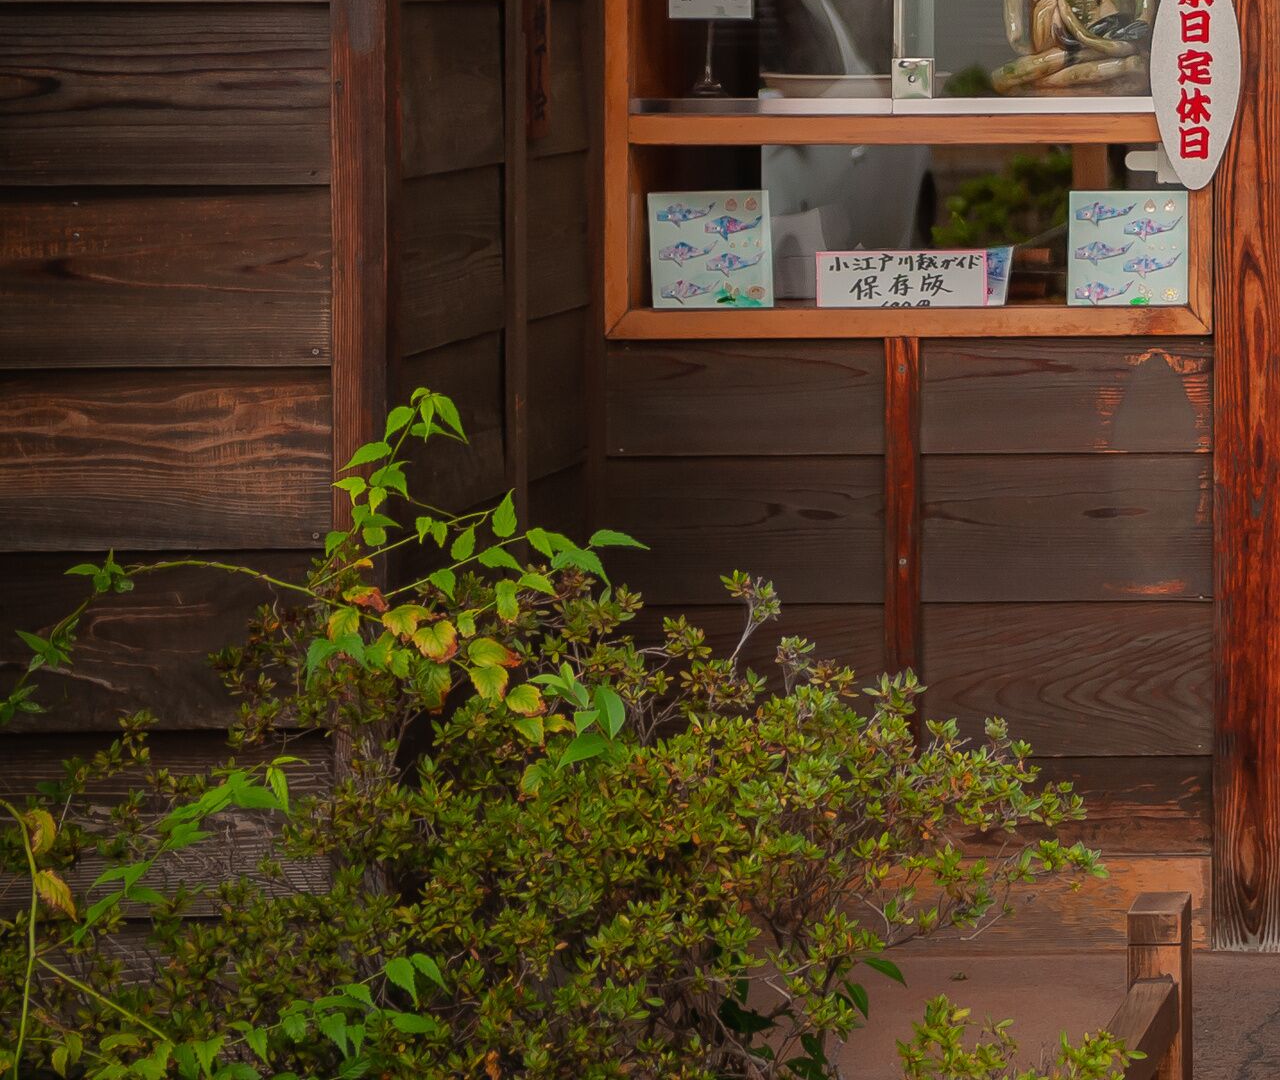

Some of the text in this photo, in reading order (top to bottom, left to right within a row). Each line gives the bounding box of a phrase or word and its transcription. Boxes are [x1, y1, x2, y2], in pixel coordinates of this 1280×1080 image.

[829, 253, 983, 272] 小江戸川越ガイド
[848, 273, 956, 300] 保存版
